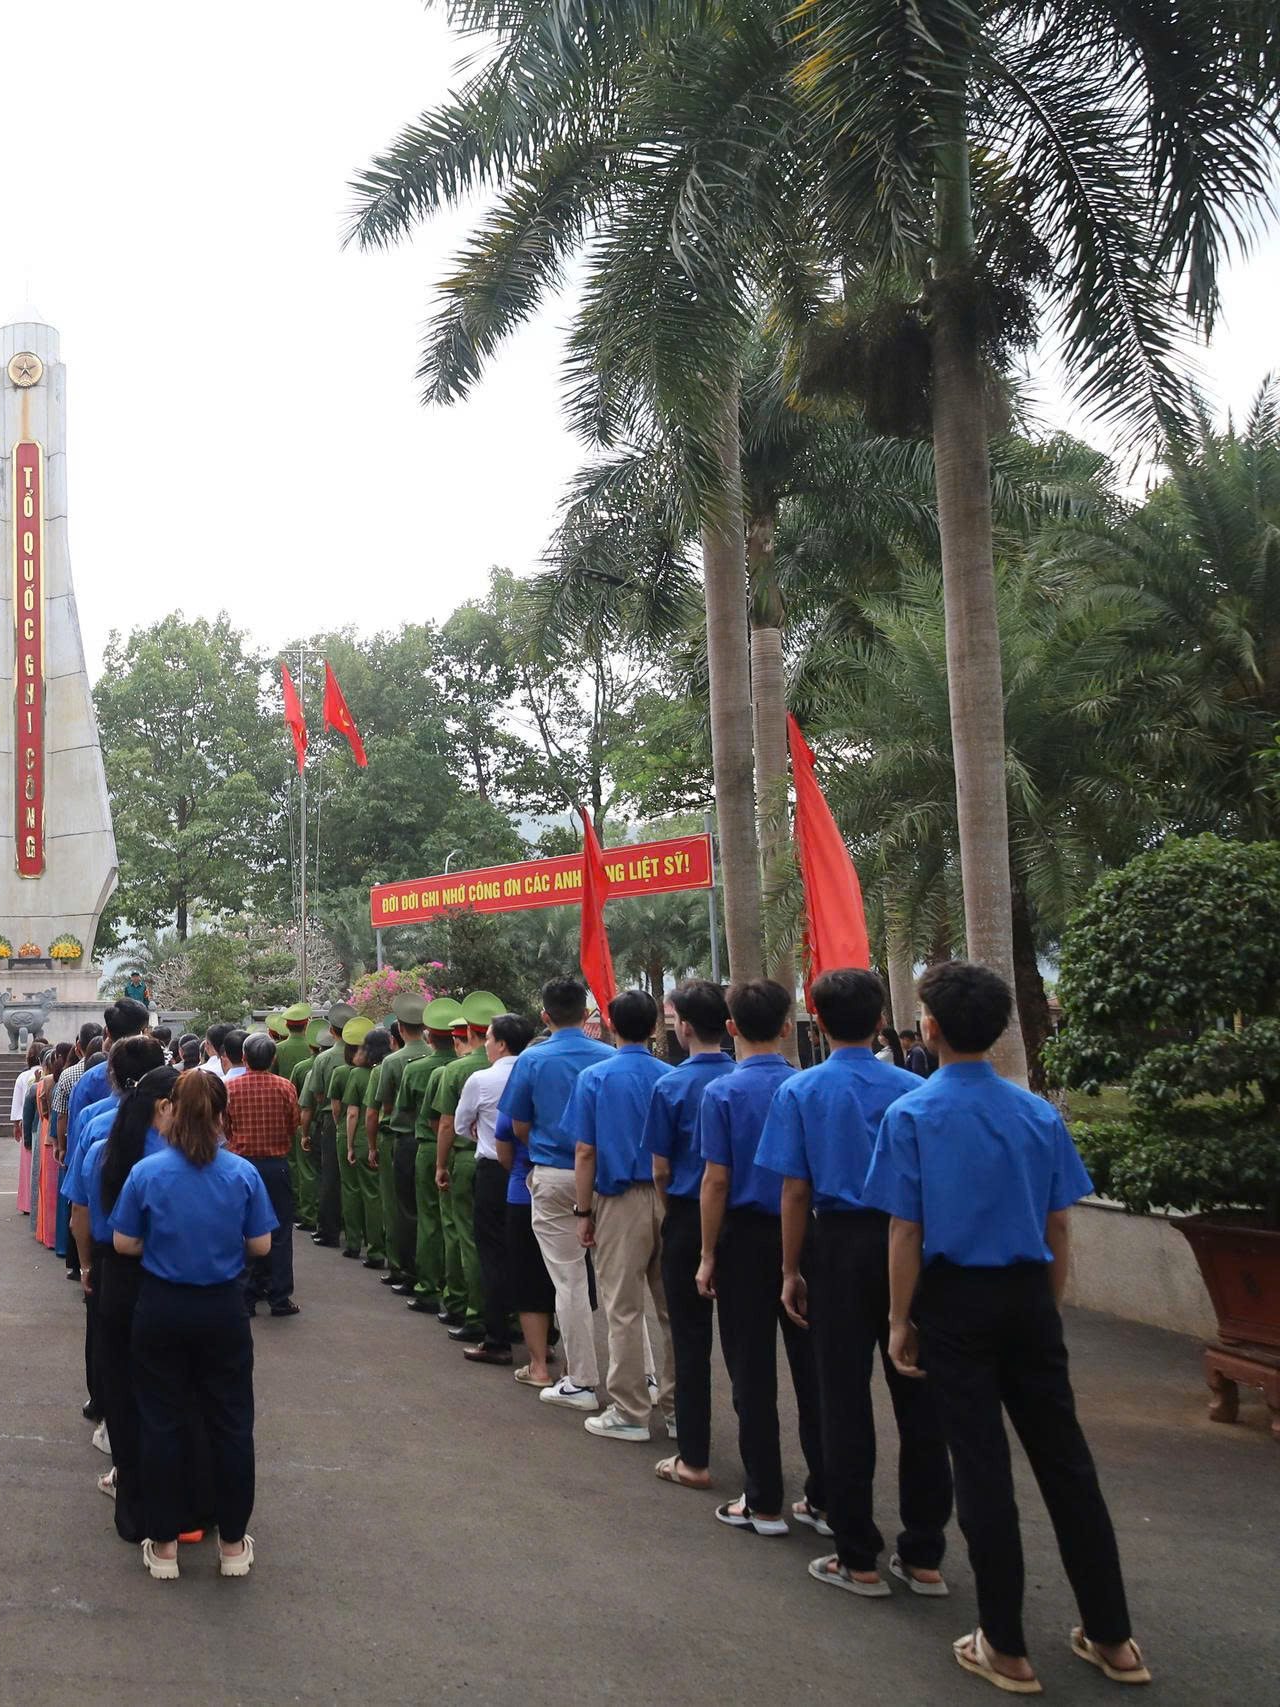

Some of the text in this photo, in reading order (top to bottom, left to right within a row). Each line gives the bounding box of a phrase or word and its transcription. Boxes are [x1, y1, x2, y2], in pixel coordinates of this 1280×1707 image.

[23, 466, 36, 858] TỔ QUỐC GHI CÔNG
[382, 893, 399, 913] ĐỜI
[402, 890, 419, 911] ĐỜI
[421, 890, 439, 908] GHI
[442, 883, 465, 906] NHỚ
[468, 880, 500, 901] CÔNG
[503, 876, 521, 896] ƠN
[524, 872, 550, 894] CÁC
[554, 869, 583, 890] ANH
[629, 855, 659, 883] LIỆT
[663, 851, 690, 876] SỸ!
